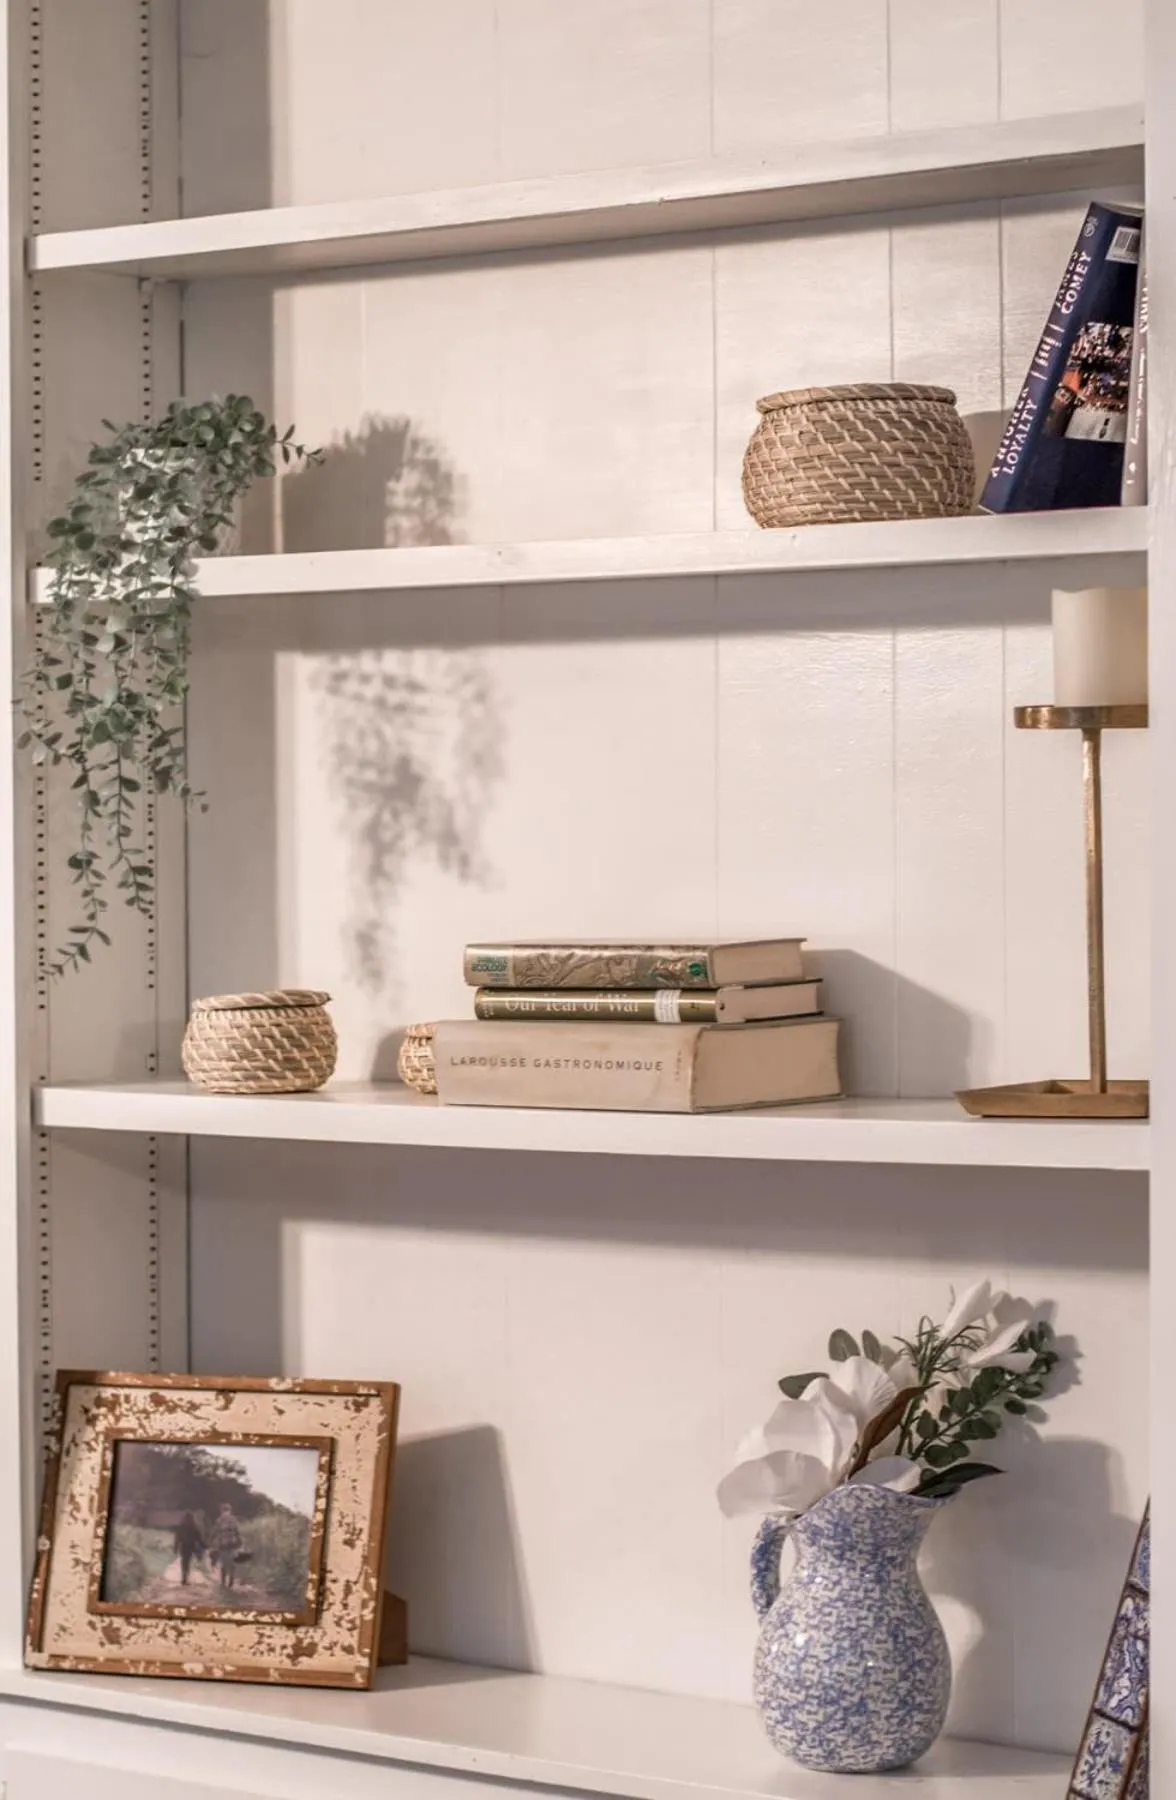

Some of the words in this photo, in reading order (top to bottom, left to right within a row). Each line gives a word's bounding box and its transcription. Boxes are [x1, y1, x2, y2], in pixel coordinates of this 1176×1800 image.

[1061, 251, 1092, 314] COMEY
[1002, 399, 1038, 475] LOYALTY
[504, 993, 537, 1013] Our
[584, 993, 600, 1012] of
[603, 993, 640, 1013] War
[450, 1056, 527, 1068] LAROUSSE
[533, 1058, 665, 1072] GASTRONOMIQUE
